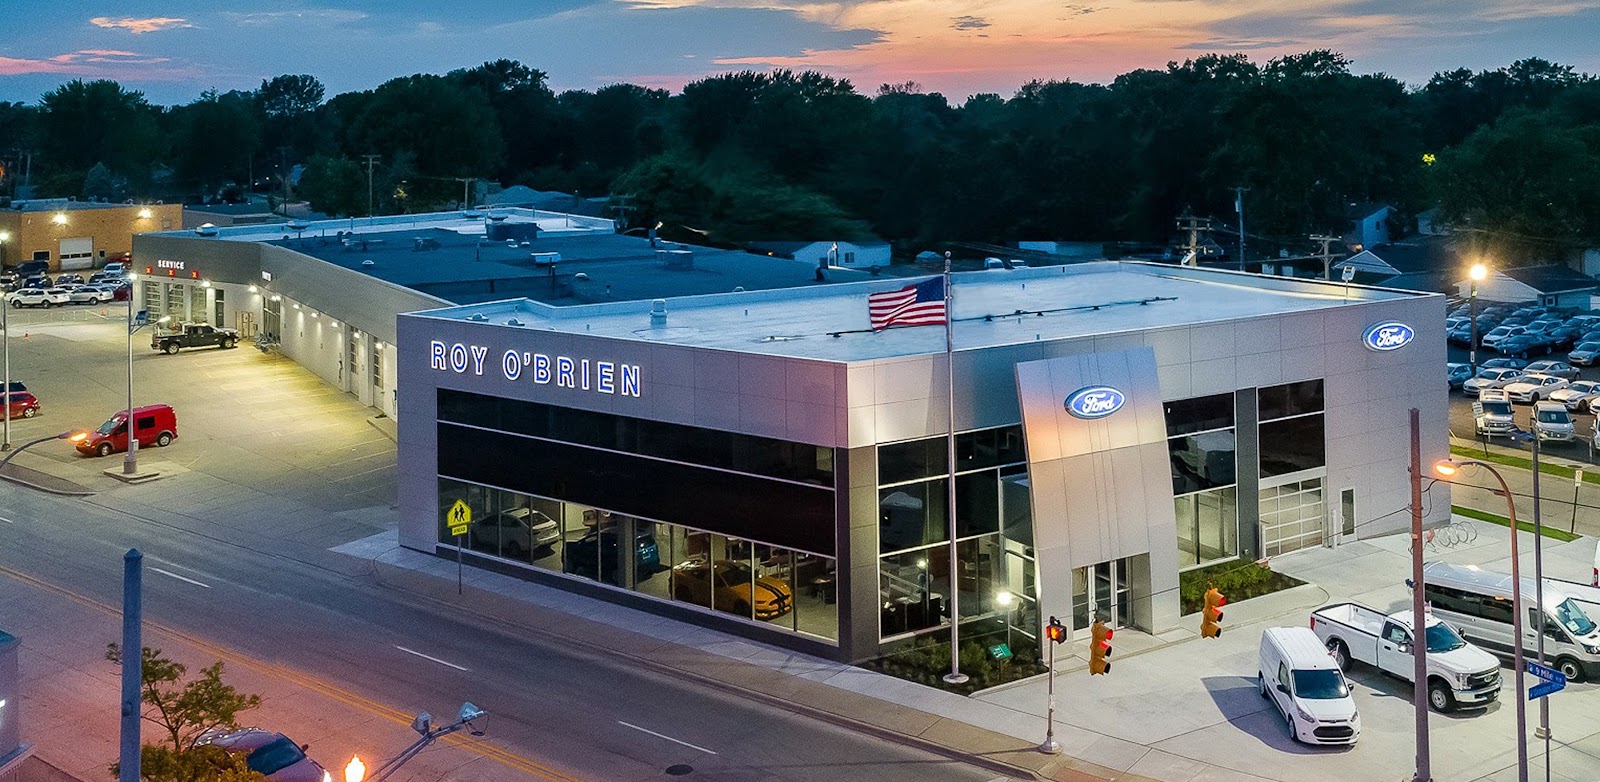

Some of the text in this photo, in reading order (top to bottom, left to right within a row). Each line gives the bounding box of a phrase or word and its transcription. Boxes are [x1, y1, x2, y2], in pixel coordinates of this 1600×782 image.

[157, 259, 185, 270] SERVICE
[1376, 327, 1406, 347] Ford
[430, 340, 641, 397] ROY O'BRIEN
[1082, 393, 1115, 414] Ford
